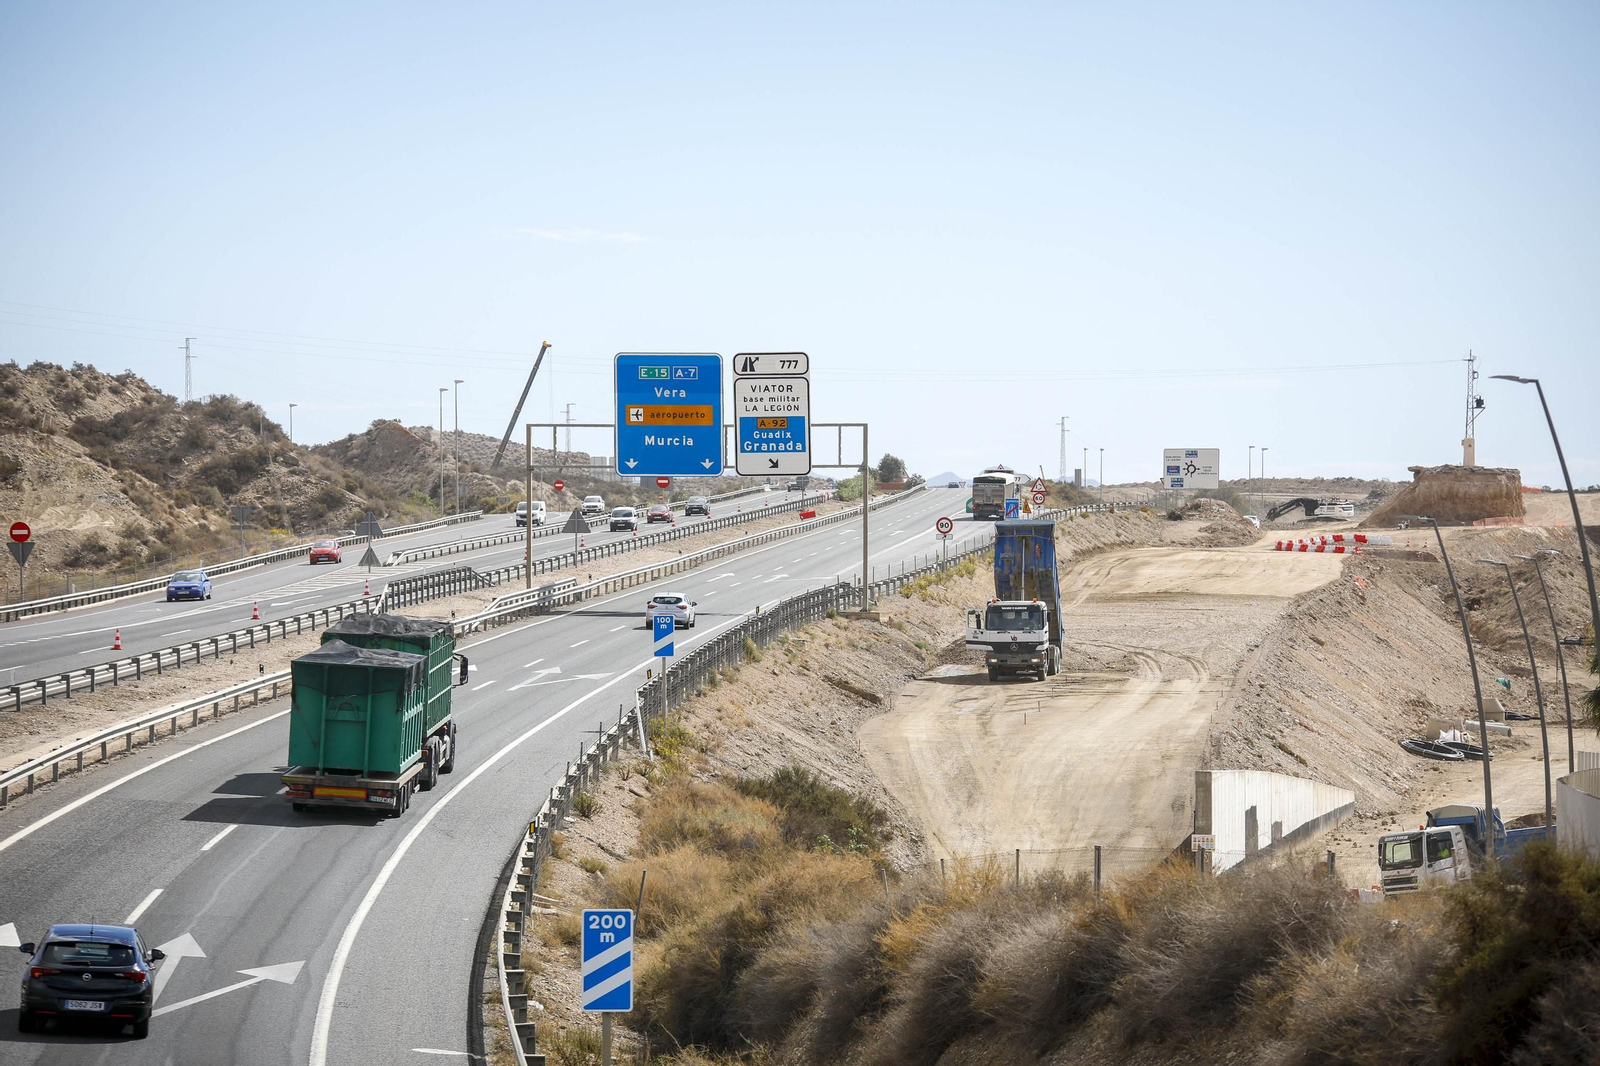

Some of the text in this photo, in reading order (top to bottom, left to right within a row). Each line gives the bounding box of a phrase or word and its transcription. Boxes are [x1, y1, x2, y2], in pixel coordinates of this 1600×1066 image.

[780, 360, 799, 369] 777
[641, 368, 695, 377] E-15 A-7
[654, 387, 686, 397] Vera
[764, 403, 800, 411] LEGIÓN
[650, 411, 706, 419] aeropuerto
[645, 435, 693, 445] Murcia
[744, 441, 802, 451] Granada
[588, 915, 626, 929] 200
[600, 932, 615, 943] m
